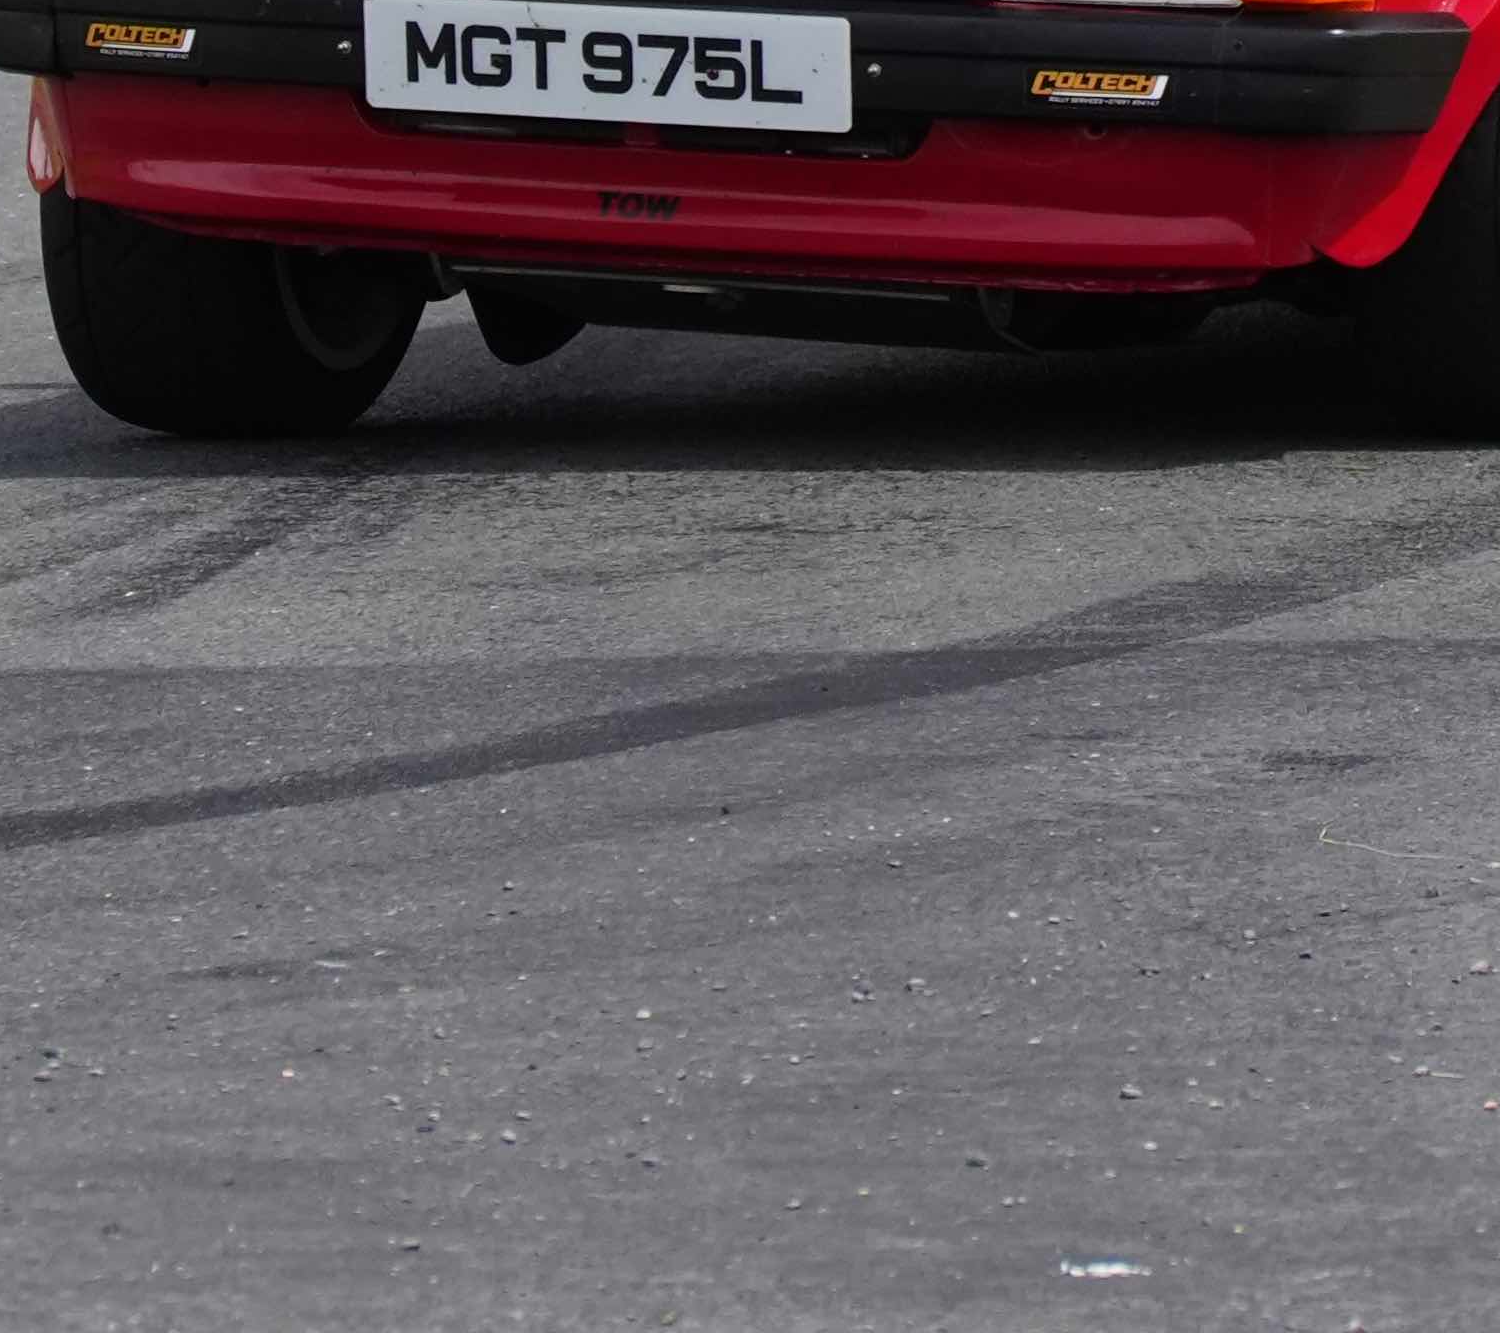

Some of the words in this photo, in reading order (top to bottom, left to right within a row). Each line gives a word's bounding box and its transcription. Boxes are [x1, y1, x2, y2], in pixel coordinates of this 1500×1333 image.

[85, 22, 187, 48] COLTECH
[405, 21, 566, 91] MGT
[581, 31, 803, 105] 975L
[1031, 71, 1158, 96] COLTECH
[598, 190, 682, 222] TOW
